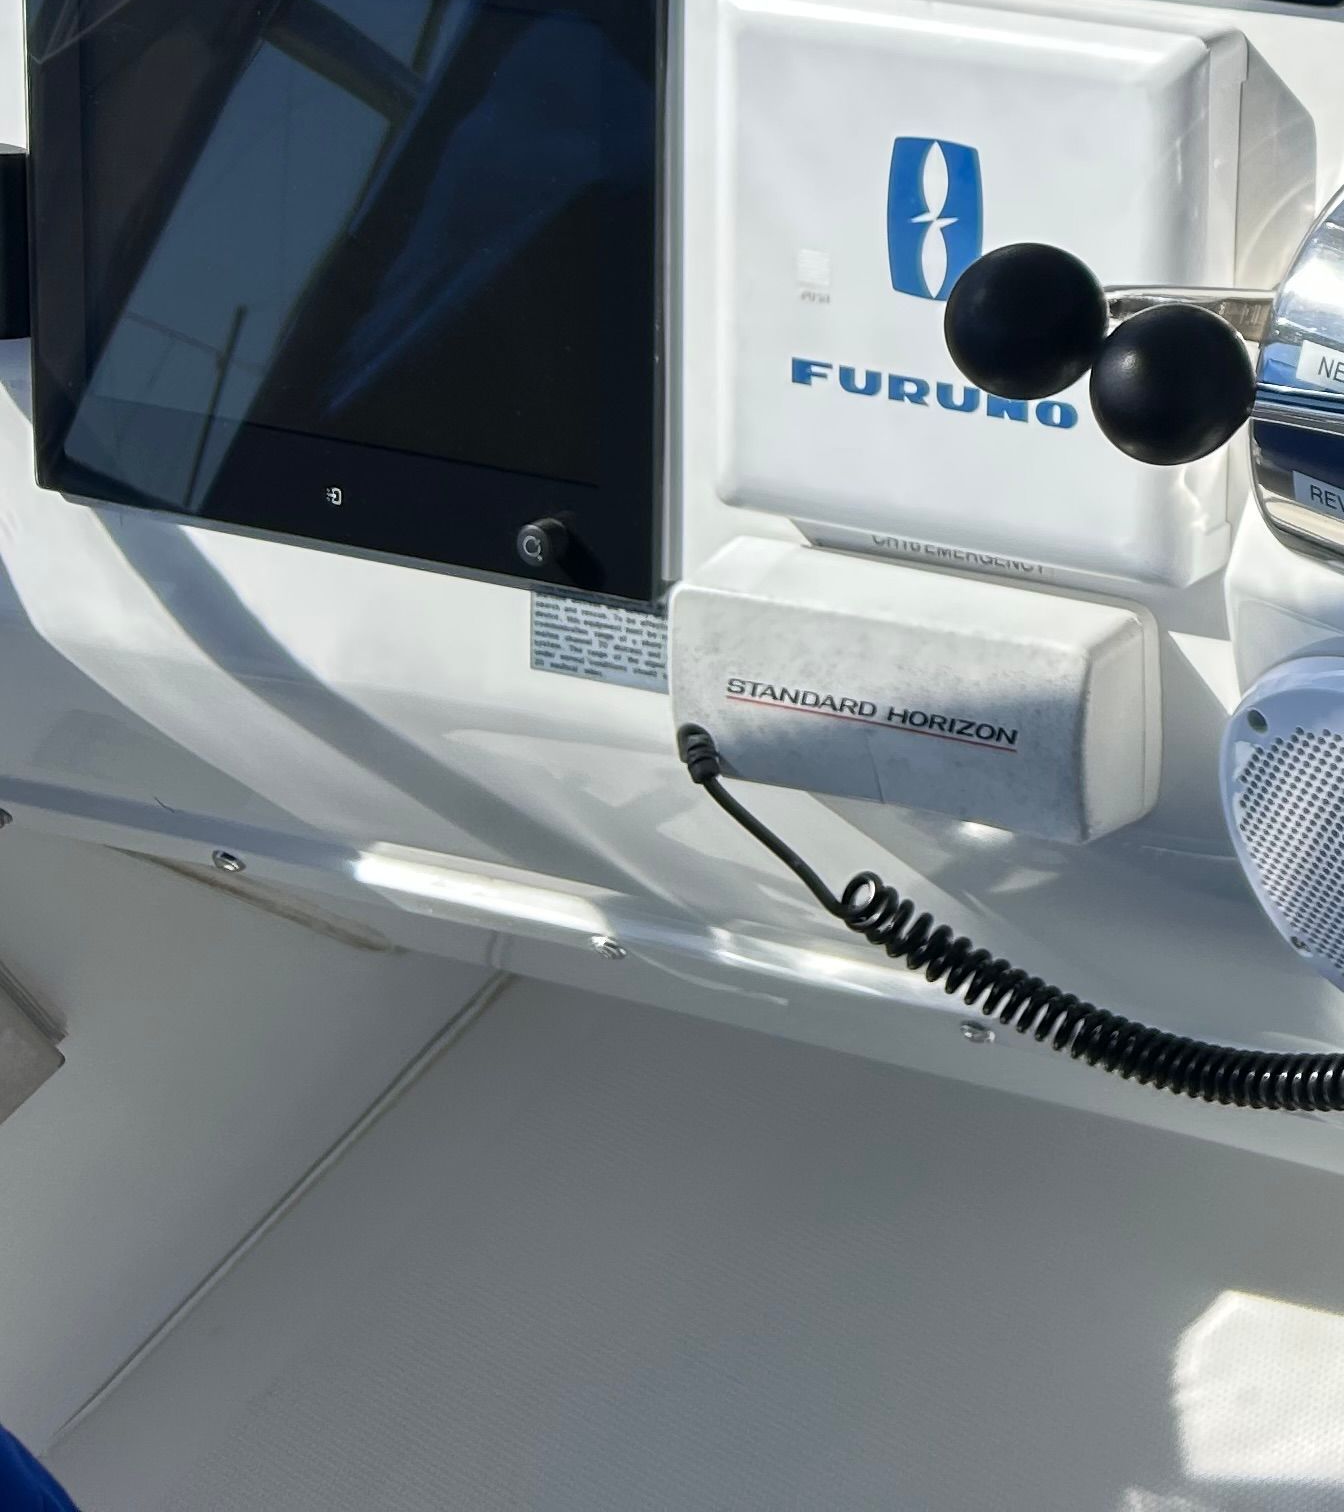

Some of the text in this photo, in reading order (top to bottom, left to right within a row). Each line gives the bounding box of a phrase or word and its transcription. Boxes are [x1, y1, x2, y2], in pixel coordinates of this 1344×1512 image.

[791, 358, 1078, 429] FURUNO
[727, 678, 1018, 745] STANDARD HORIZON
